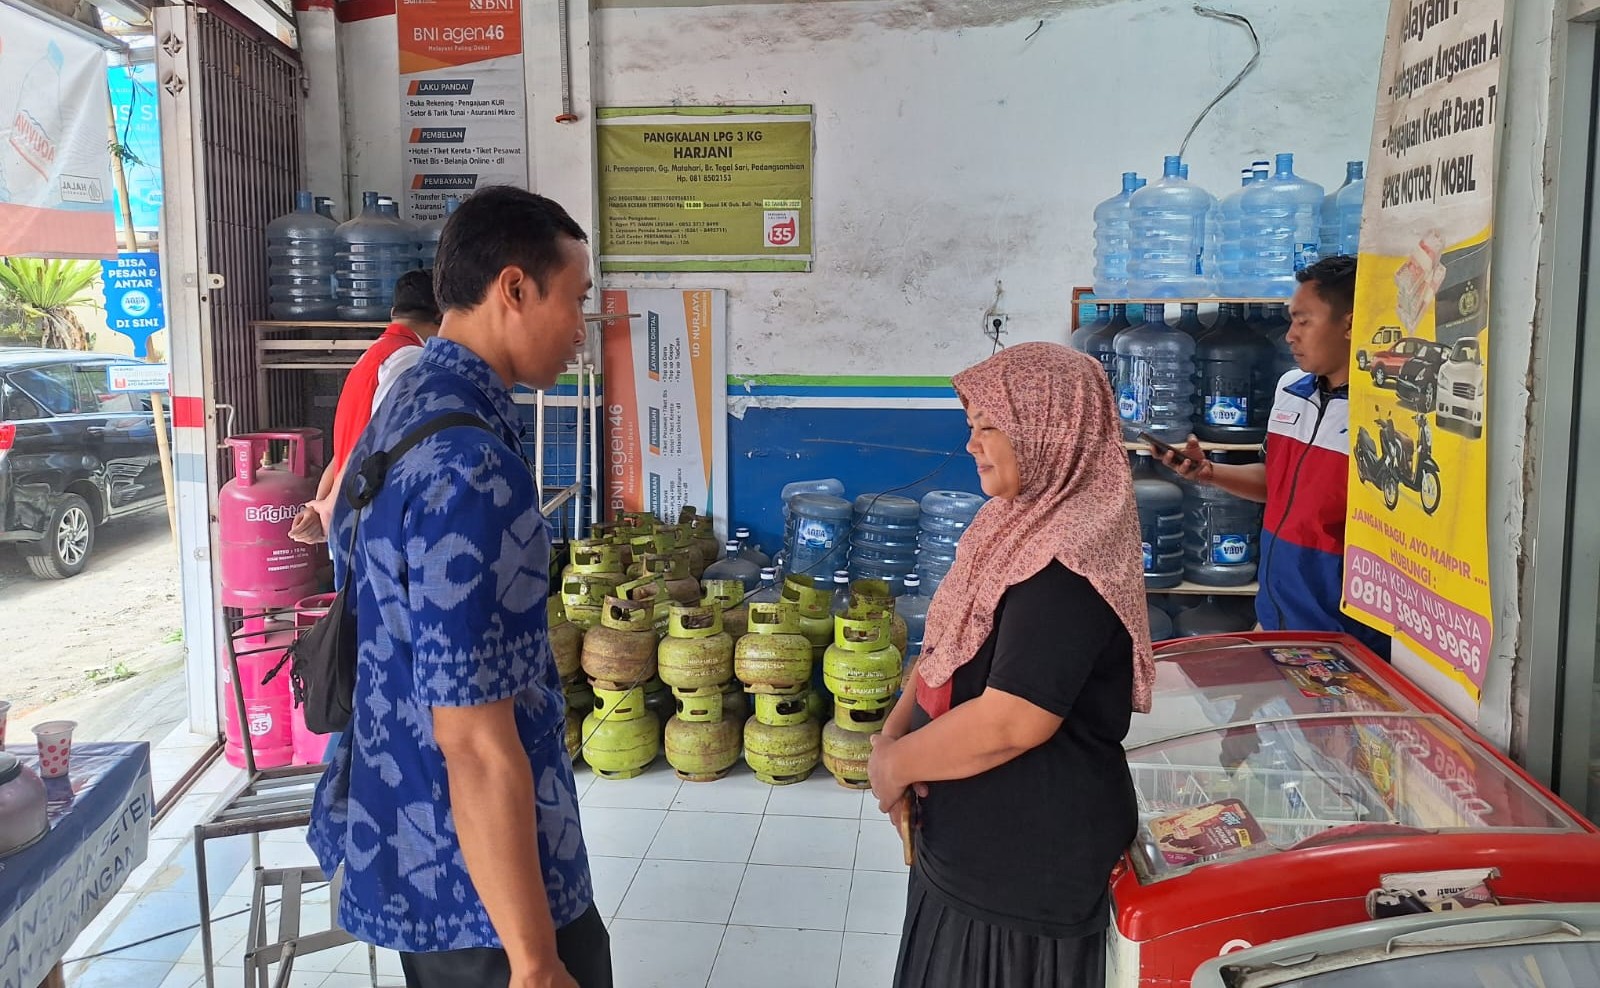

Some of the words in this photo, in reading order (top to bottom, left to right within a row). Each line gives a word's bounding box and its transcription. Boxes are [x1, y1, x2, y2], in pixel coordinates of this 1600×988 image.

[486, 0, 513, 10] BNI
[413, 27, 439, 42] BNI
[442, 24, 505, 44] agen46
[1434, 33, 1487, 83] Angsuran
[441, 83, 469, 91] PANDAI
[426, 100, 454, 108] Rekening
[458, 99, 490, 108] Pengajuan
[470, 108, 497, 116] Asuransi
[498, 108, 516, 116] Mikro
[1422, 99, 1452, 143] Kredit
[1454, 96, 1484, 134] Dana
[422, 131, 463, 139] PEMBELIAN
[643, 132, 710, 142] PANGKALAN
[713, 132, 734, 142] LPG
[736, 132, 744, 142] 3
[746, 131, 762, 141] KG
[673, 146, 732, 158] HARJANI
[444, 157, 468, 166] Belanja
[658, 164, 670, 174] Gg.
[671, 164, 703, 173] Matahari,
[424, 177, 473, 186] PEMBAYARAN
[676, 174, 687, 183] Hp.
[689, 174, 702, 182] 081
[1400, 164, 1432, 204] MOTOR
[1441, 154, 1476, 198] MOBIL
[414, 193, 440, 201] Transfer
[118, 259, 146, 267] BISA
[108, 269, 146, 278] PESAN
[114, 280, 153, 288] ANTAR
[692, 292, 700, 340] NURJAYA
[116, 320, 130, 328] DI
[132, 318, 160, 327] SINI
[692, 342, 700, 358] UD
[1212, 410, 1237, 420] AQUA
[608, 404, 628, 476] agen46
[611, 480, 624, 510] BNI
[246, 504, 297, 523] Bright
[1352, 508, 1384, 534] JANGAN
[1409, 537, 1428, 558] AYO
[1223, 546, 1244, 555] AQUA
[1351, 554, 1388, 586] ADIRA
[1390, 547, 1431, 585] HUBUNGI
[1350, 575, 1392, 614] 0819
[1396, 596, 1433, 641] 3899
[1436, 623, 1480, 674] 9966
